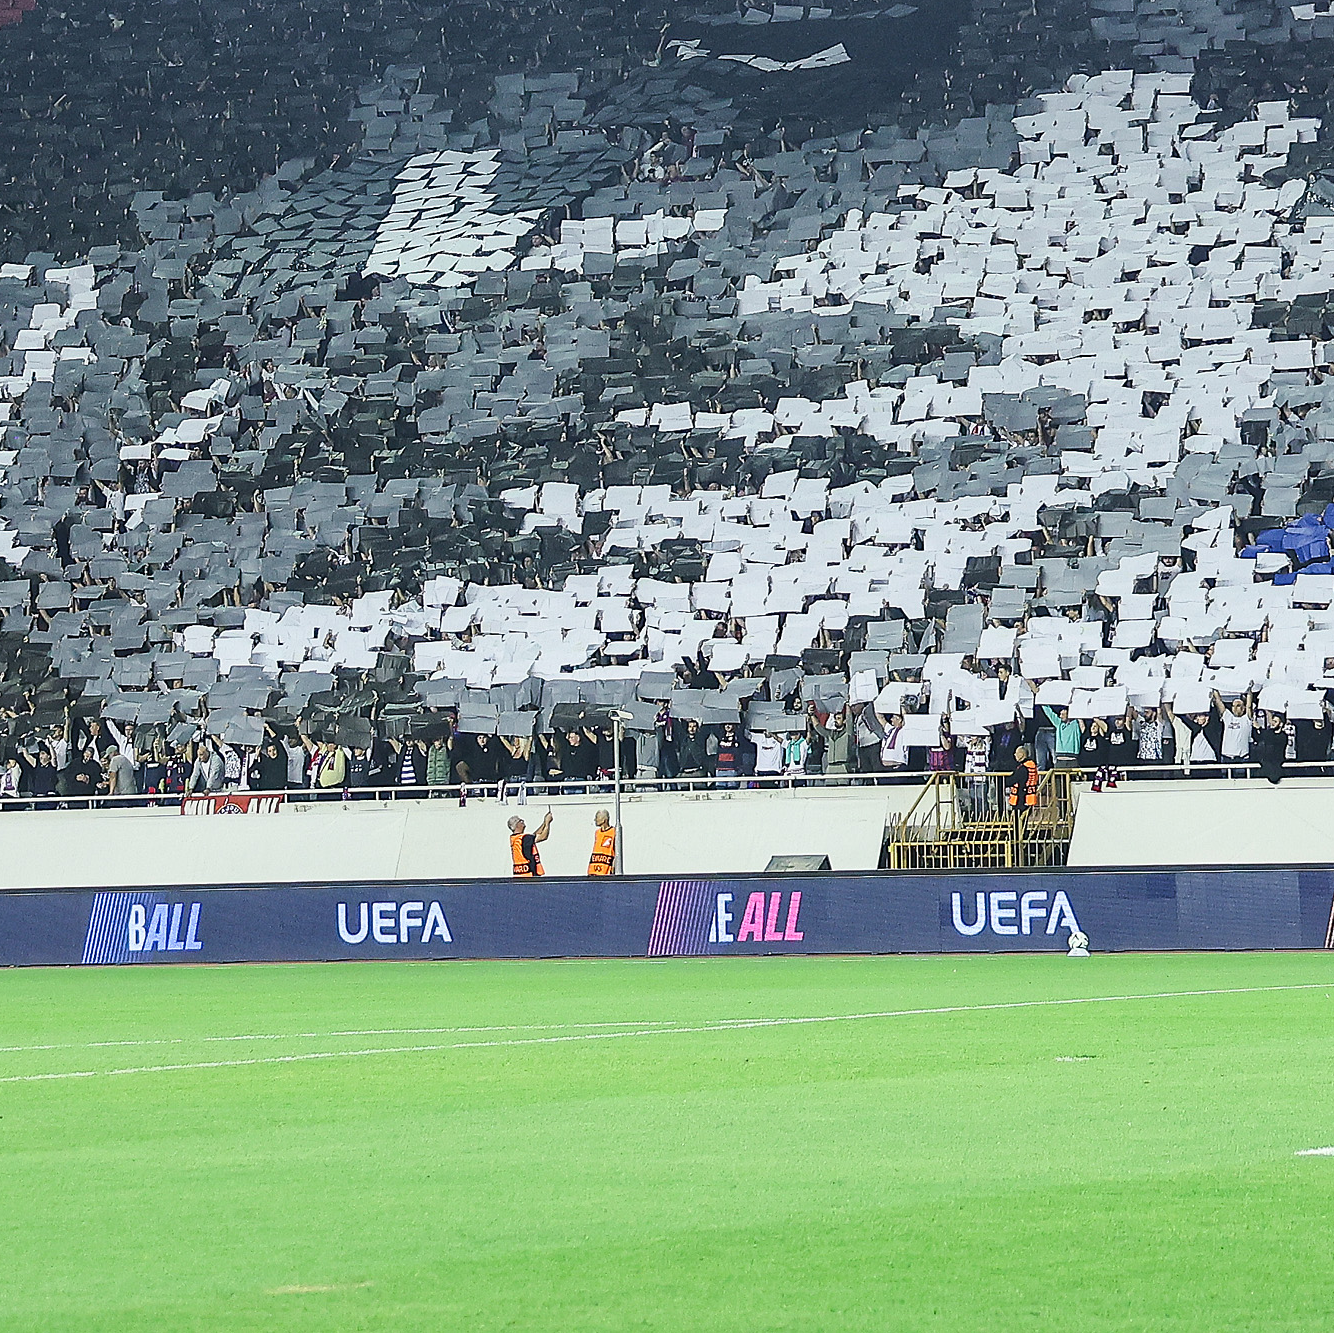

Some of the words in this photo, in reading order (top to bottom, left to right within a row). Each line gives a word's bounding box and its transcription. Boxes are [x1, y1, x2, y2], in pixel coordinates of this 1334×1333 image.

[128, 902, 203, 952] BALL
[337, 901, 453, 944] UEFA
[737, 891, 805, 942] ALL
[951, 890, 1082, 936] UEFA
